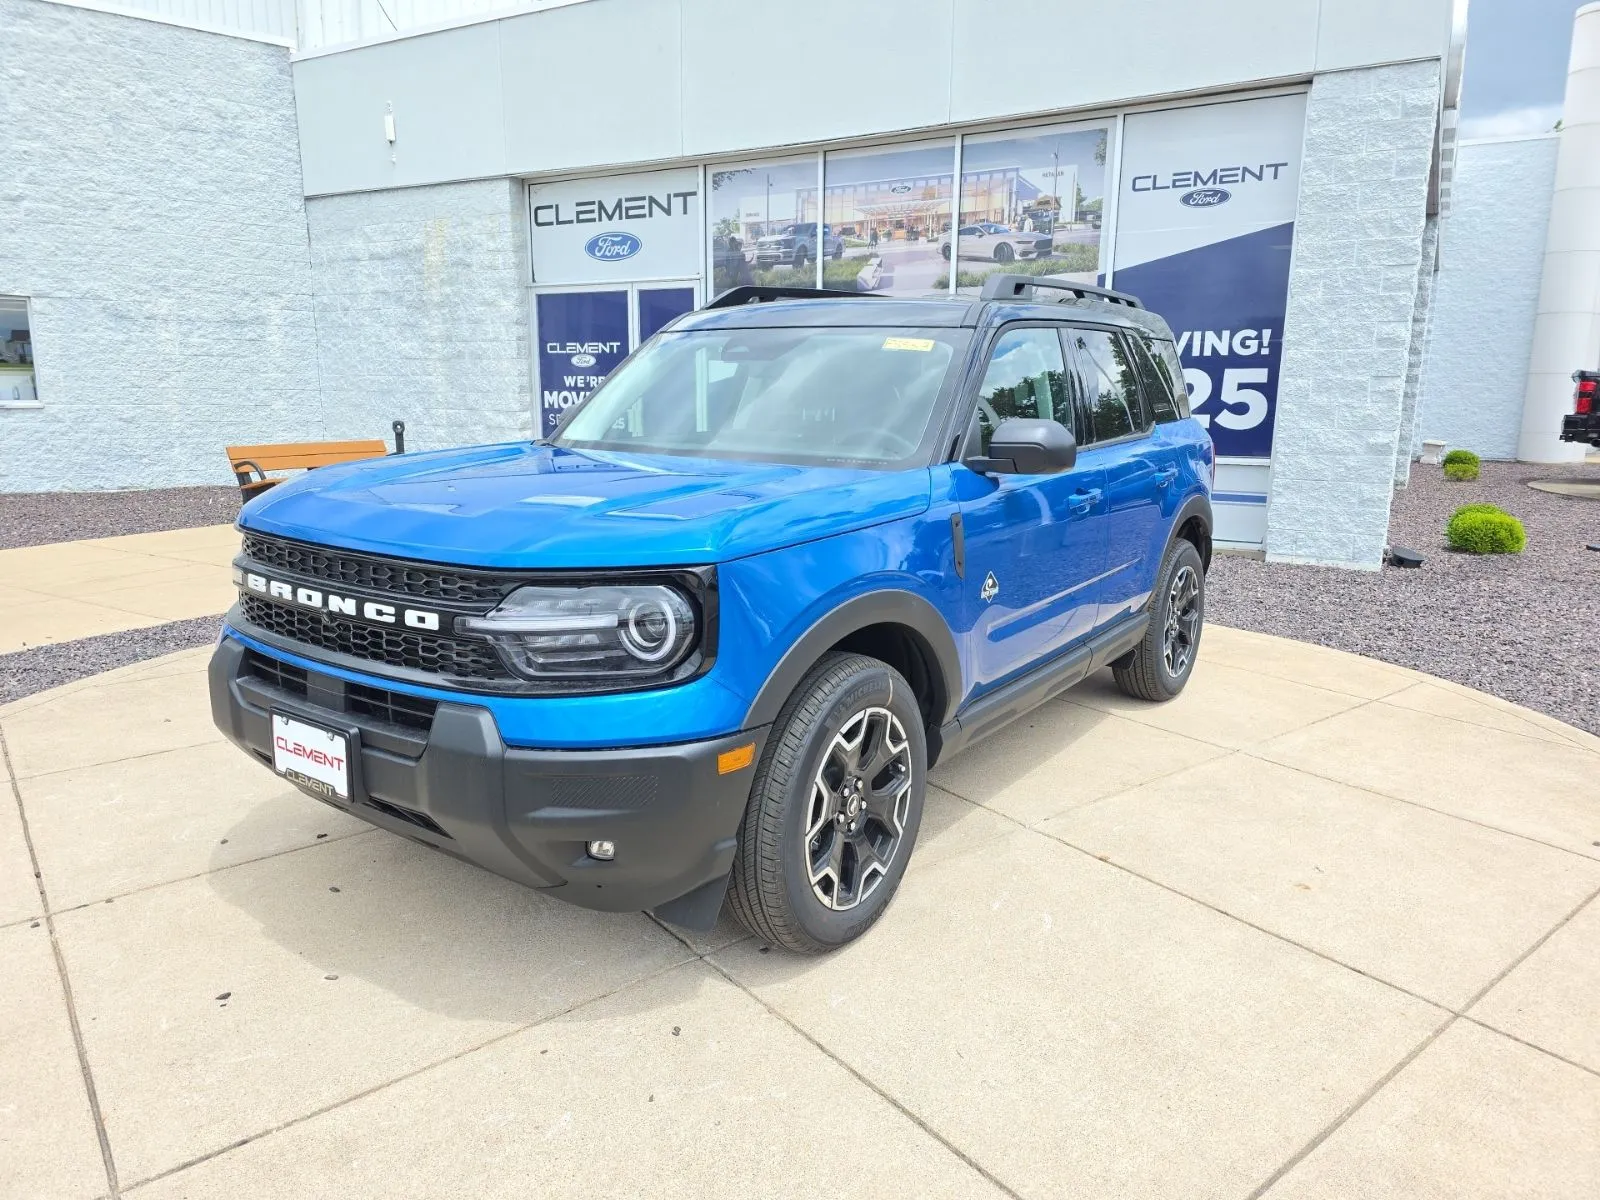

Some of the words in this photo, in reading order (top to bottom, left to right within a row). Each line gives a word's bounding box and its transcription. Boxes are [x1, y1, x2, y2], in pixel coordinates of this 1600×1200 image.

[1132, 162, 1288, 192] CLEMENT
[533, 191, 697, 227] CLEMENT
[1190, 192, 1221, 205] Ford
[595, 236, 630, 256] Ford
[547, 342, 620, 354] CLEMENT
[248, 573, 439, 631] BRONCO
[277, 736, 344, 771] CLEMENT
[287, 769, 334, 796] CLEMENT
